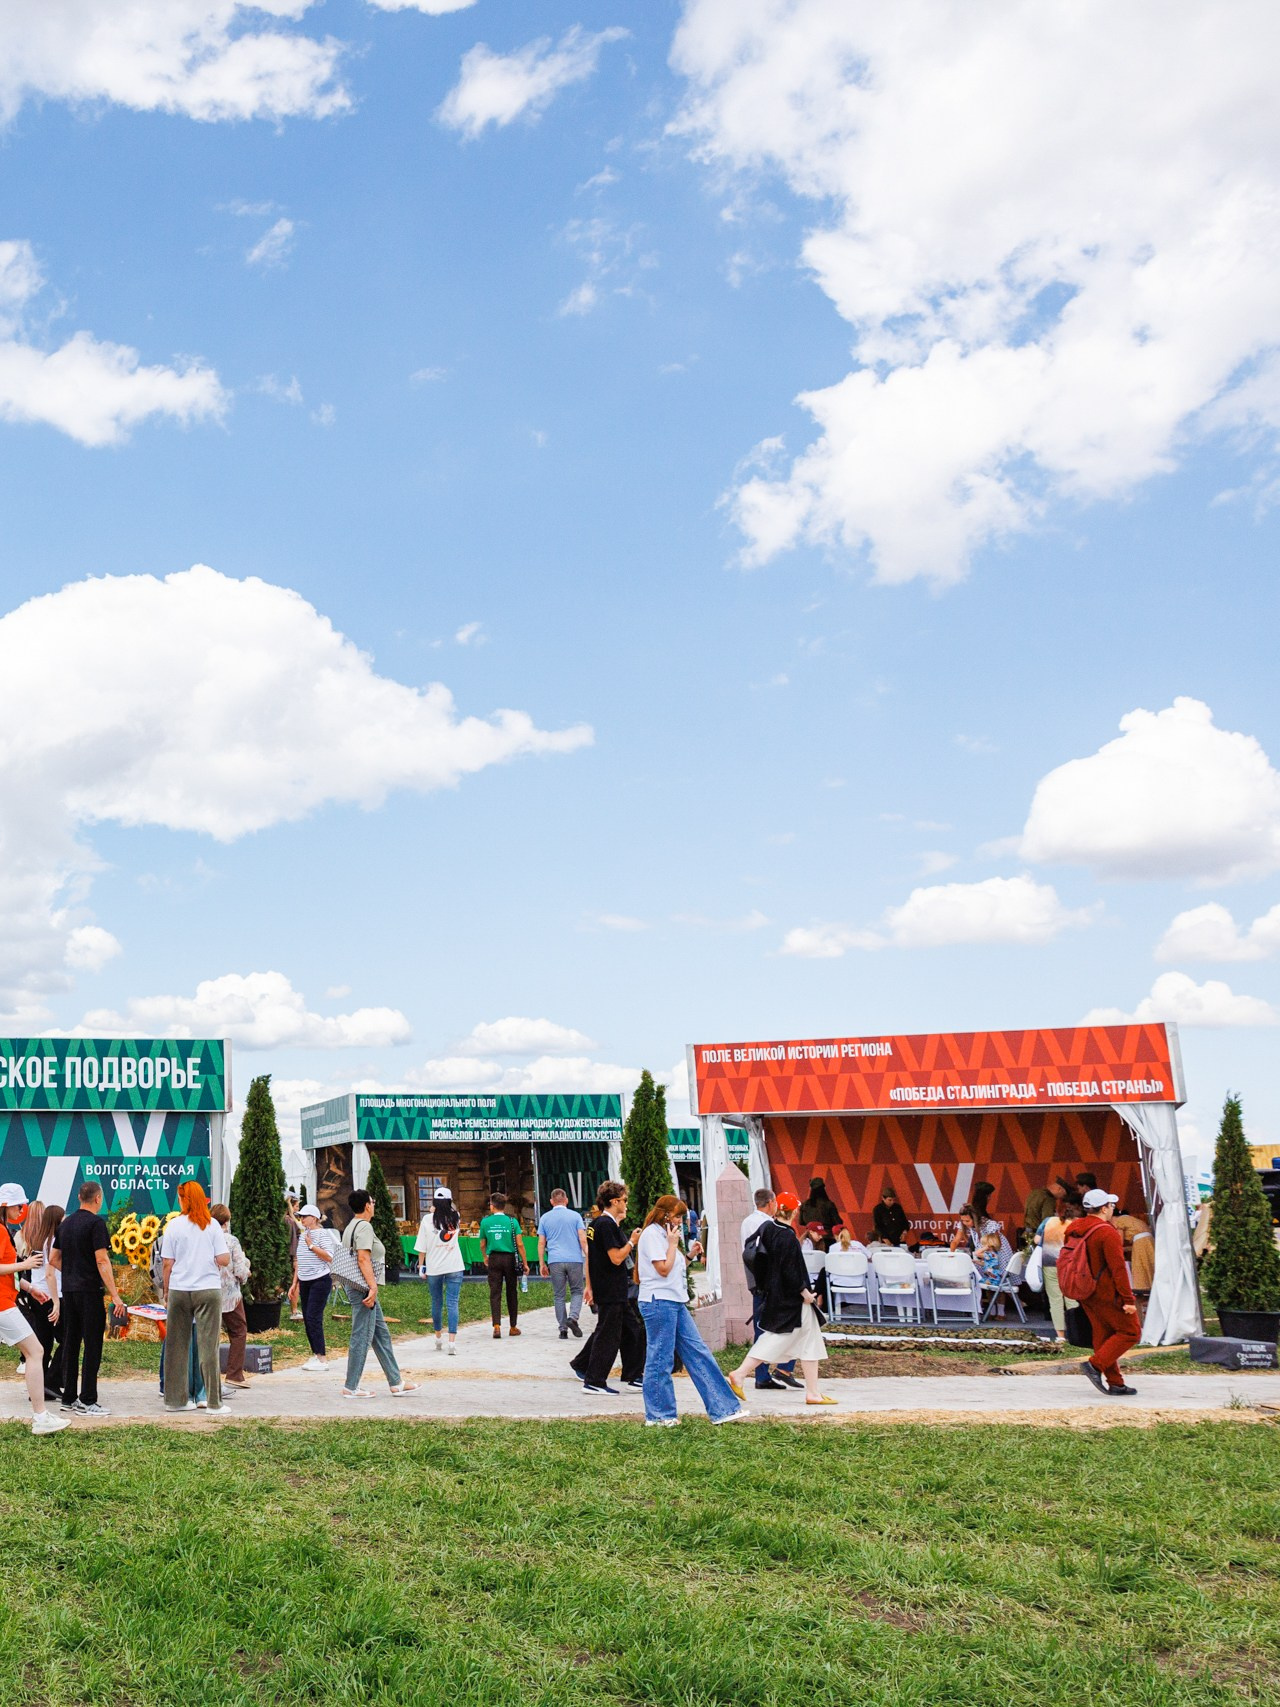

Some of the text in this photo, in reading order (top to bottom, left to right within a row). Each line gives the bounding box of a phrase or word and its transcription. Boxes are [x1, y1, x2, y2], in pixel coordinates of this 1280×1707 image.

[702, 1042, 893, 1064] ПОЛЕ ВЕЛИКОЙ ИСТОРИИ РЕГИОНА
[65, 1056, 201, 1092] ПОДВОРЬЕ
[889, 1085, 945, 1102] «ПОБЕДА
[946, 1083, 1037, 1100] СТАЛИНГРАДА
[1047, 1081, 1100, 1097] ПОБЕДА
[1102, 1079, 1164, 1096] СТРАНЫ»
[360, 1098, 497, 1108] ПЛОЩАДЬ МНОГОНАЦИОНАЛЬНОГО ПОЛЯ
[431, 1118, 621, 1128] МАСТЕРА-РЕМЕСЛЕННИКИ НАРОДНО-ХУДОЖЕСТВЕННЫХ
[429, 1130, 622, 1141] ПРОМЫСЛОВ И ДЕКОРАТИВНО-ПРИКЛАДНОГО ИСКУССТВА
[85, 1164, 195, 1176] ВОЛГОГРАДСКАЯ
[110, 1178, 170, 1190] ОБЛАСТЬ
